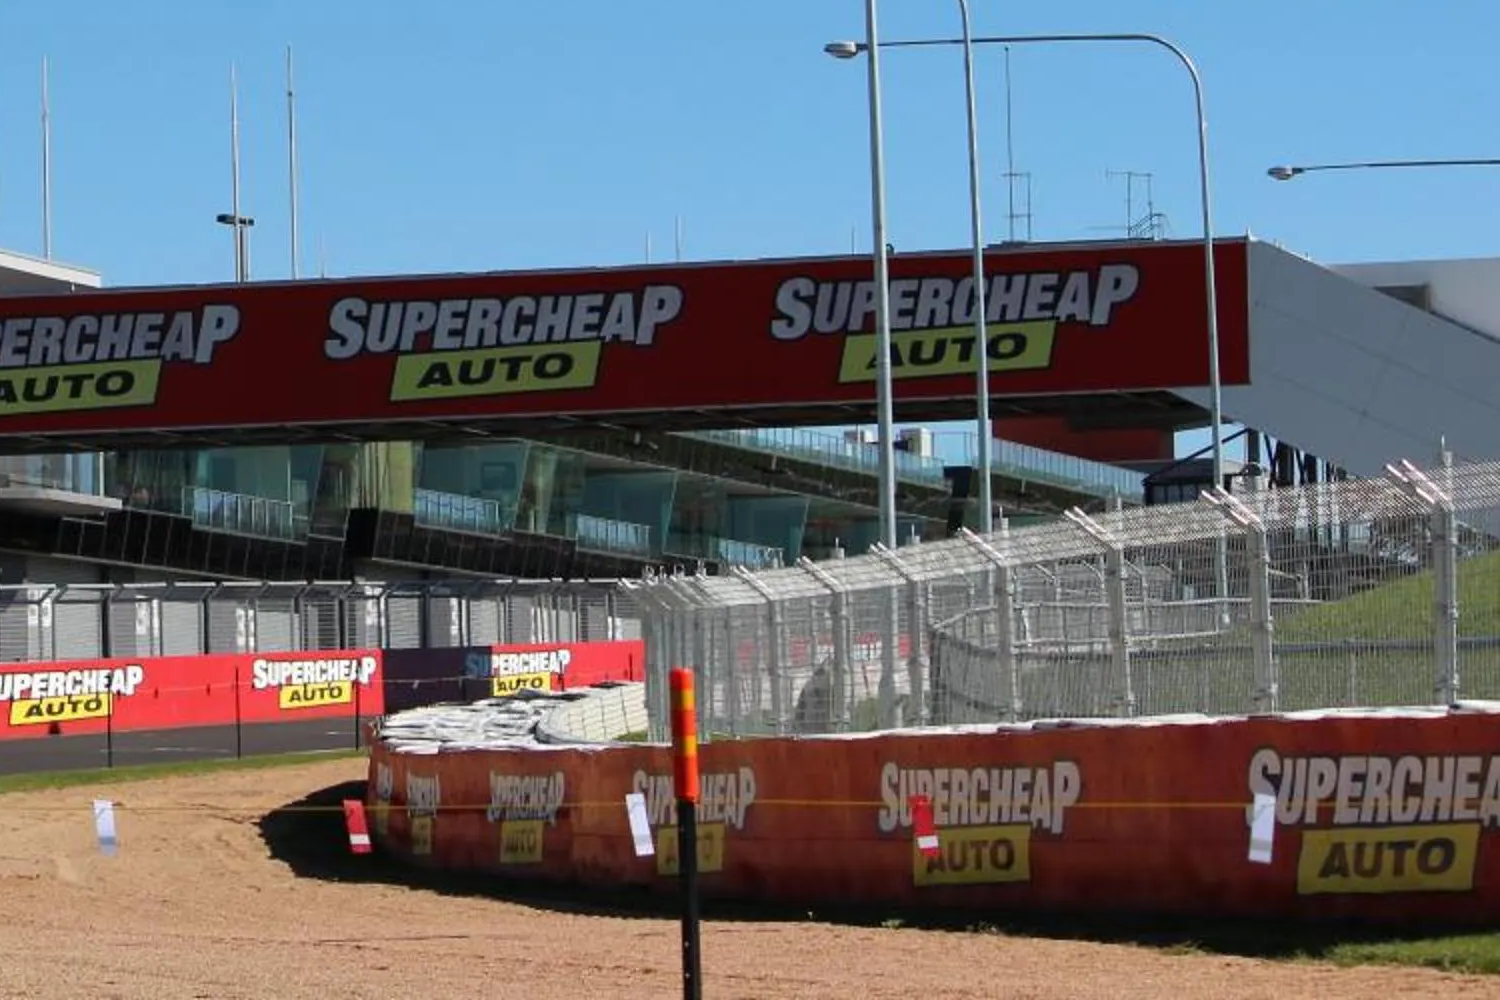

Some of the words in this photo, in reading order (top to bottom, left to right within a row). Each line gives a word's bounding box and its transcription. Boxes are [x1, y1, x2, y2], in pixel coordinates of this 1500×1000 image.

[771, 264, 1139, 340] SUPERCHEAP
[324, 285, 682, 359] SUPERCHEAP
[867, 333, 1028, 369] AUTO
[417, 352, 574, 388] AUTO
[289, 686, 343, 702] AUTO
[497, 677, 543, 692] AUTO
[25, 699, 103, 718] AUTO
[879, 761, 1081, 834] SUPERCHEAP
[1317, 837, 1457, 879] AUTO
